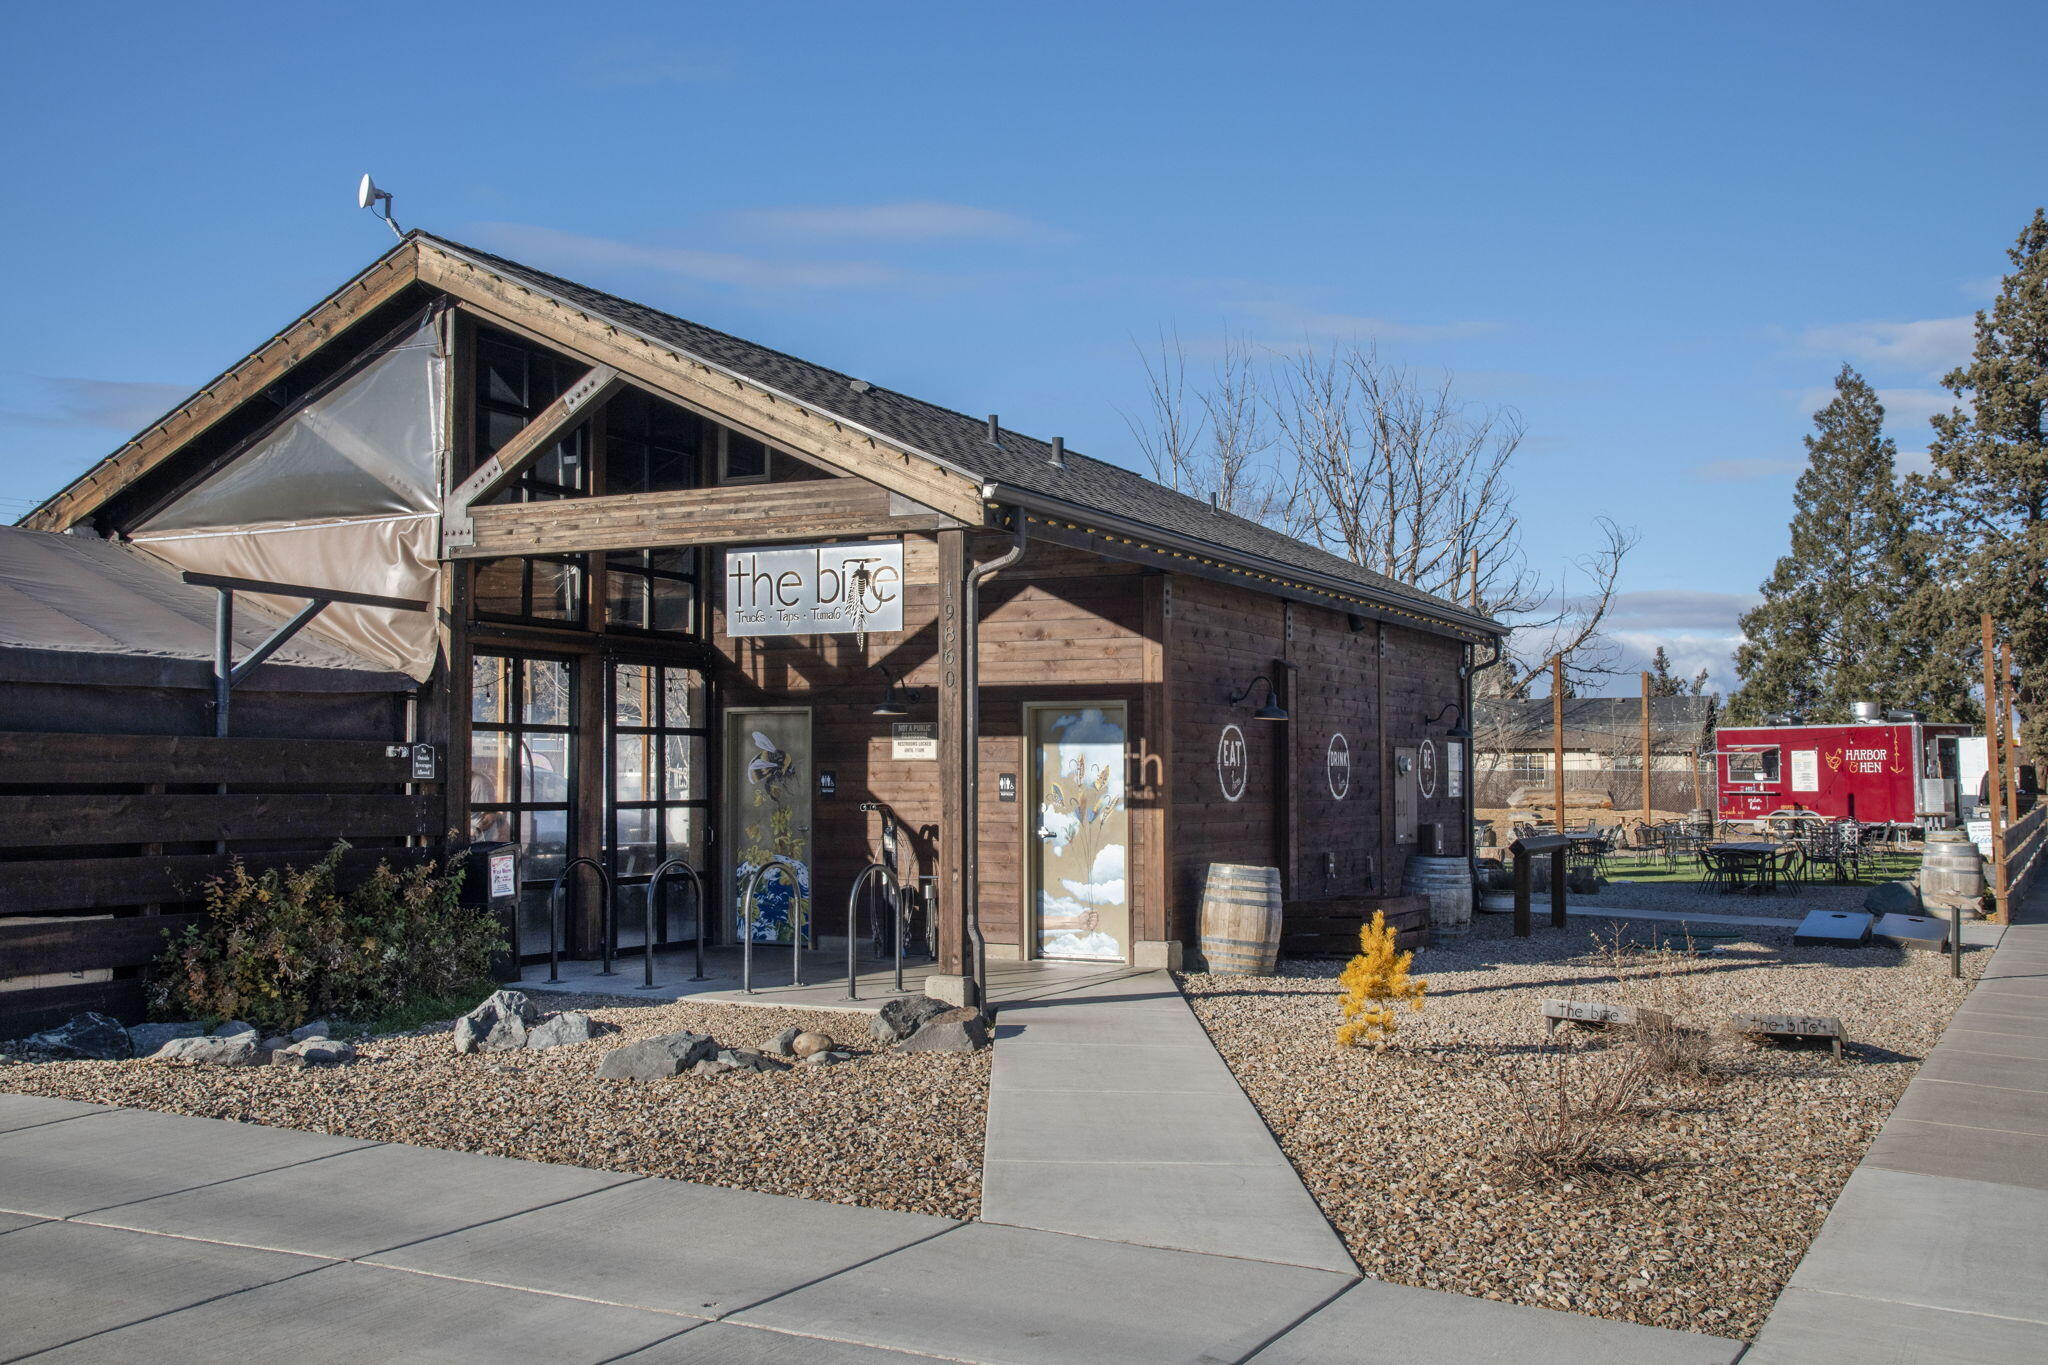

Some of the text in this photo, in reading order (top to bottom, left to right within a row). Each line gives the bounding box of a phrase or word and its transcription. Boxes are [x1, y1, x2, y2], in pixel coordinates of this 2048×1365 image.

[729, 549, 899, 613] the bite
[735, 610, 765, 623] Trucks
[776, 609, 799, 627] Taps
[945, 581, 955, 687] 19860
[1224, 740, 1241, 767] EAT
[1330, 752, 1347, 767] DRINK
[1423, 749, 1431, 769] BE
[1845, 749, 1887, 761] HARBOR
[1859, 762, 1882, 773] HEN
[1558, 1002, 1619, 1021] the bite
